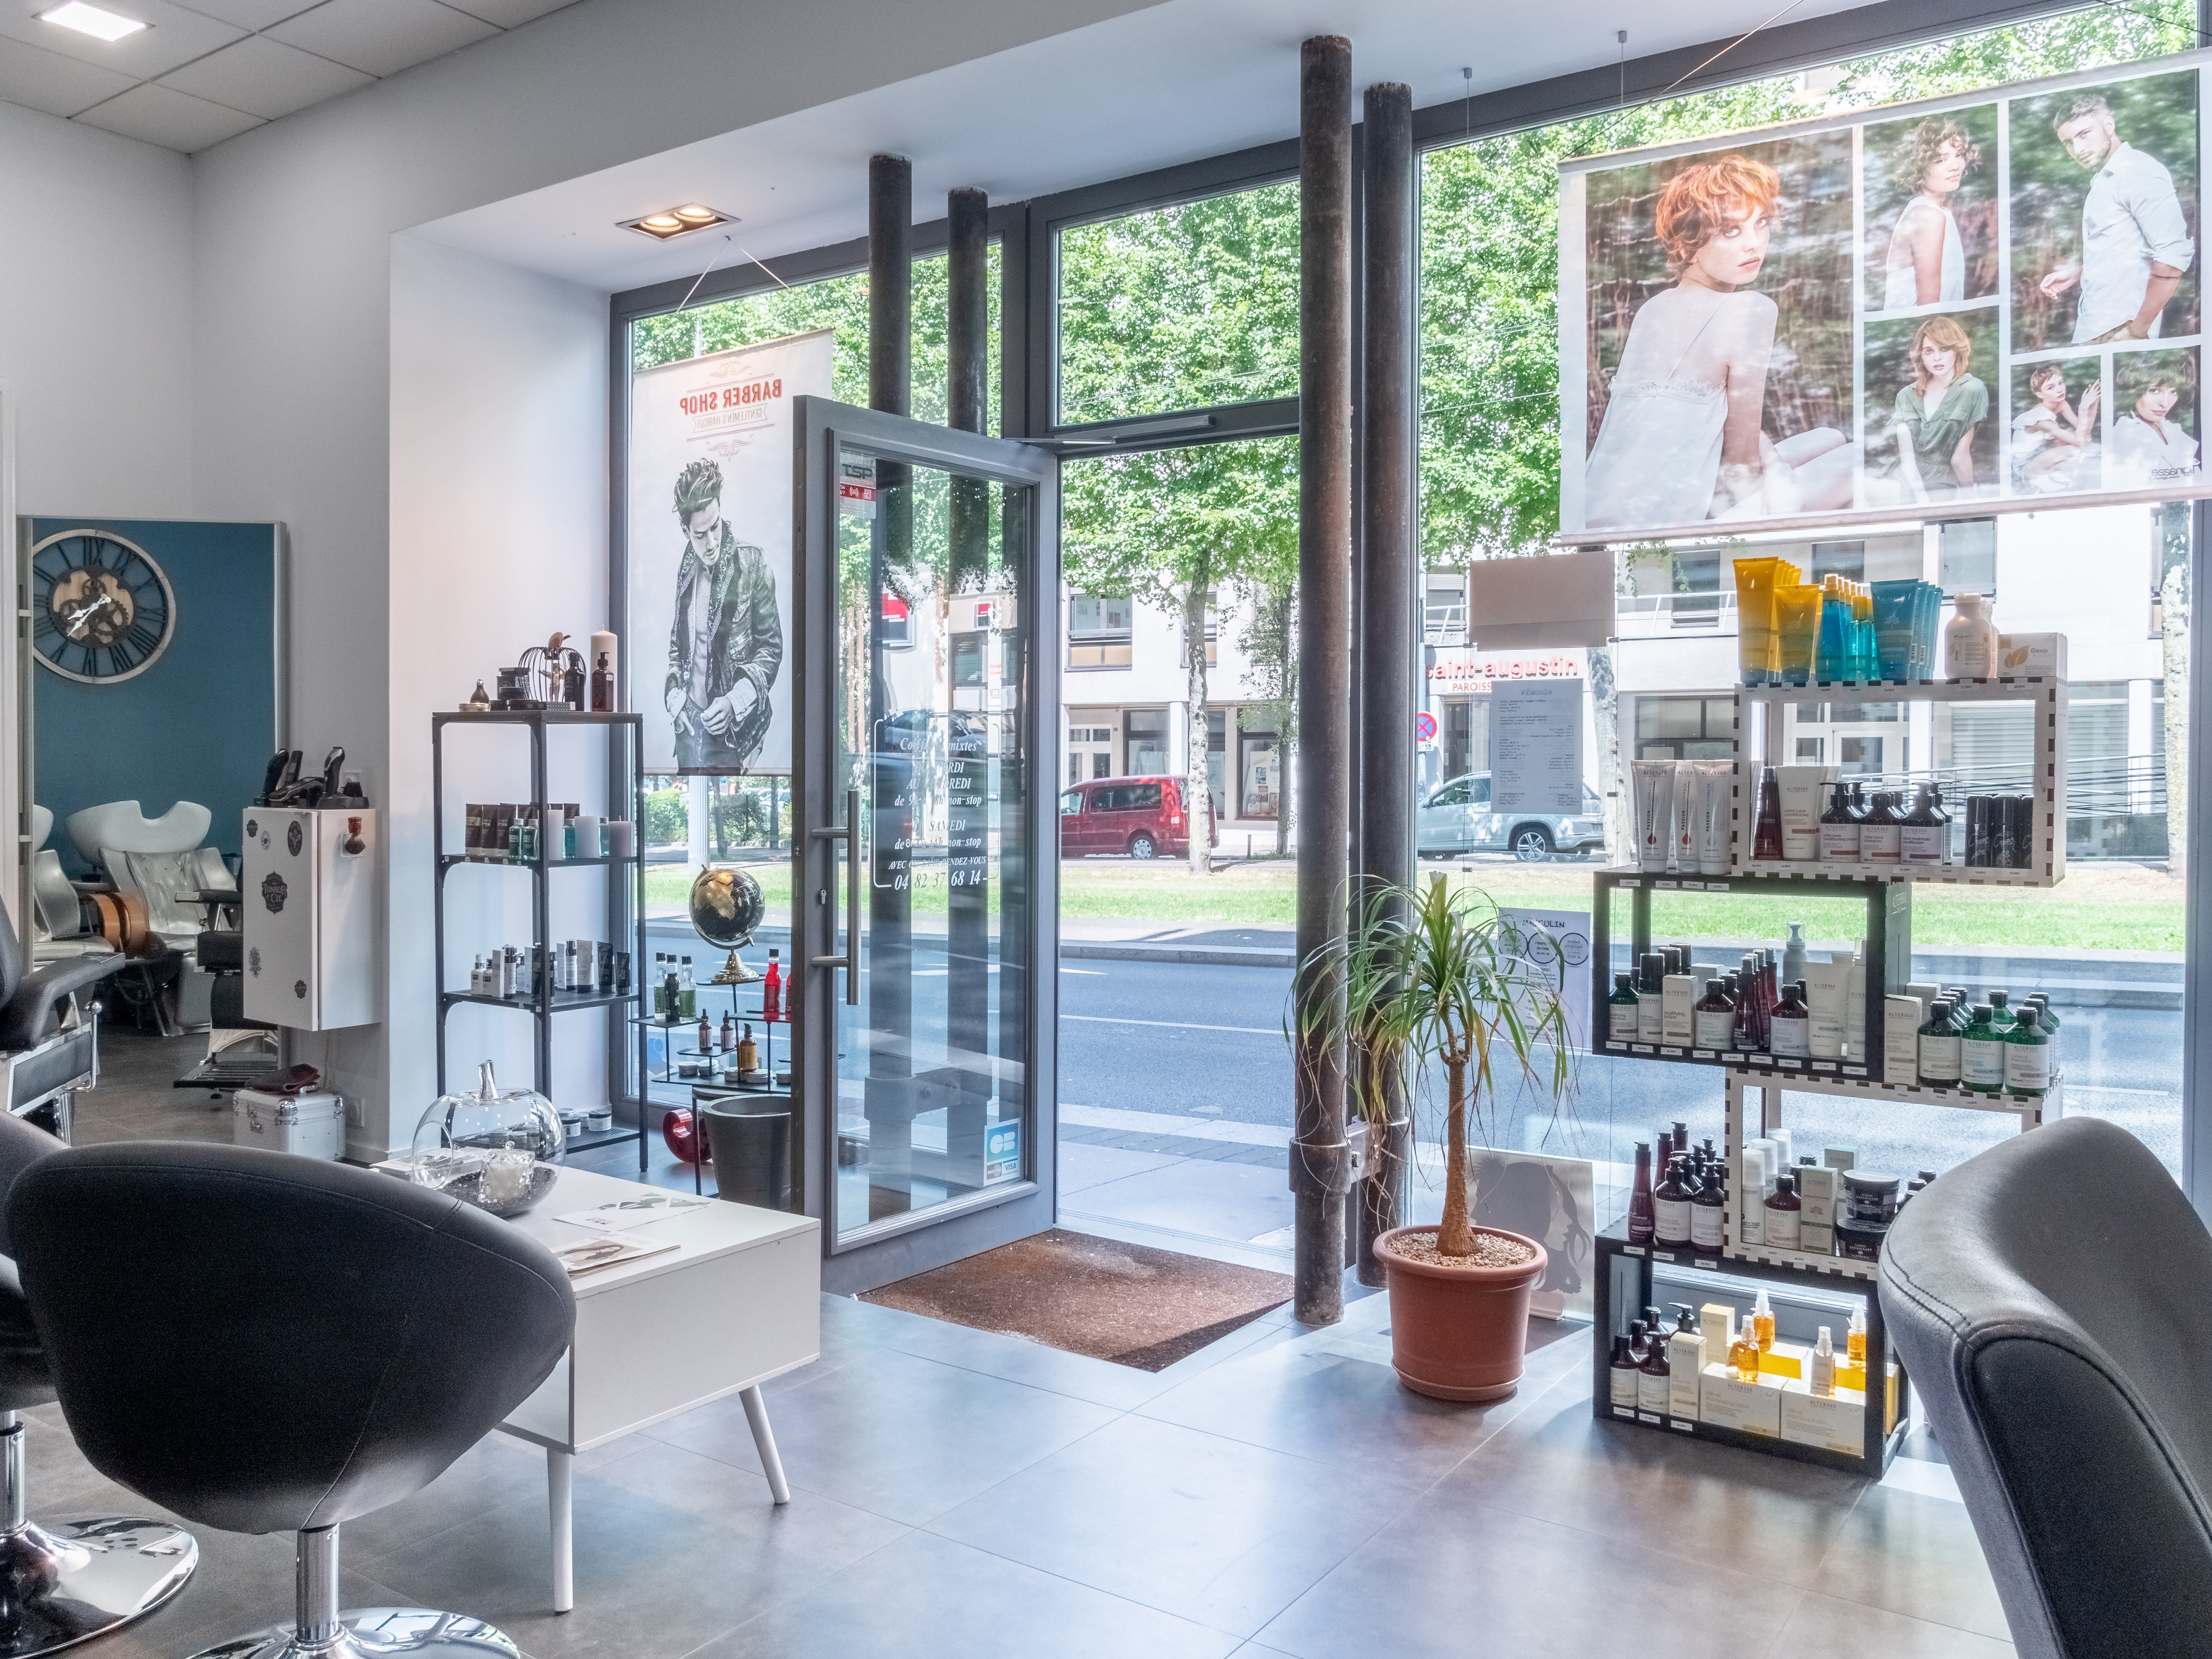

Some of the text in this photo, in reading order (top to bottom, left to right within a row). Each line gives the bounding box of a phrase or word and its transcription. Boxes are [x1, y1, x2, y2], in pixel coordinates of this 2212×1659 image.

[1453, 683, 1492, 691] PAROISS
[948, 739, 977, 751] mixtes
[906, 778, 921, 789] AU
[894, 795, 905, 806] de
[948, 795, 982, 807] non-stop
[929, 820, 966, 831] SAMEDI
[894, 838, 905, 850] de
[948, 837, 981, 848] non-stop
[888, 861, 906, 870] AVEC
[942, 856, 987, 866] RENDEZ-VOUS
[894, 870, 981, 891] 04 82 37 68 14
[1522, 919, 1565, 928] MAULIN
[1005, 1163, 1016, 1171] VISA
